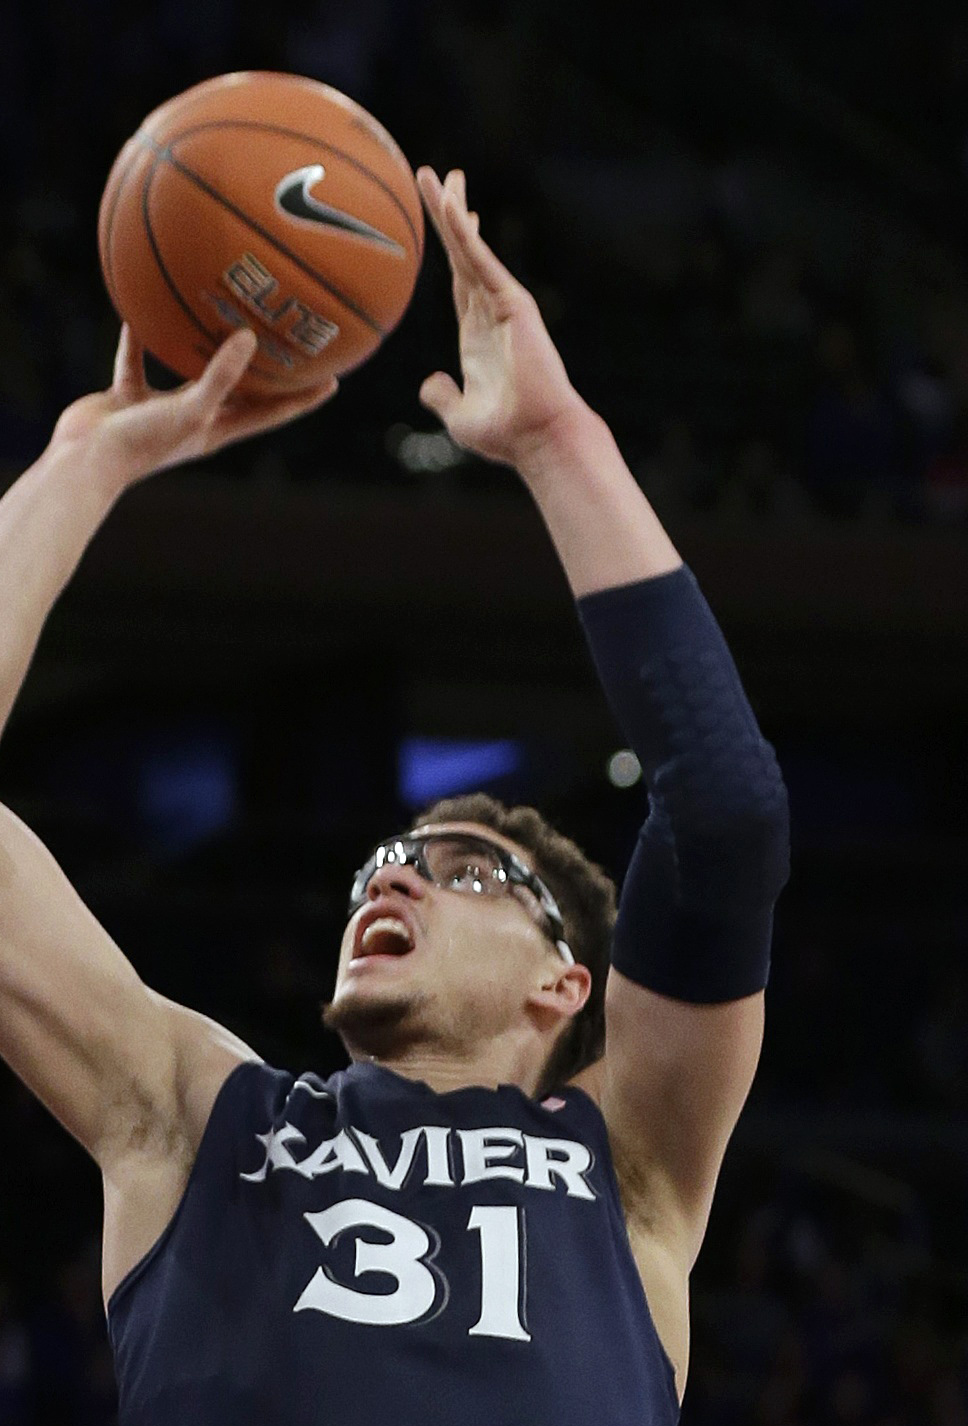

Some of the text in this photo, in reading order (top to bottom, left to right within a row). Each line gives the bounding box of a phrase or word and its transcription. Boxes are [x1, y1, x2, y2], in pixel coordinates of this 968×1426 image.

[222, 251, 340, 358] ELITE
[239, 1120, 597, 1202] XAVIER
[292, 1198, 532, 1342] 31
